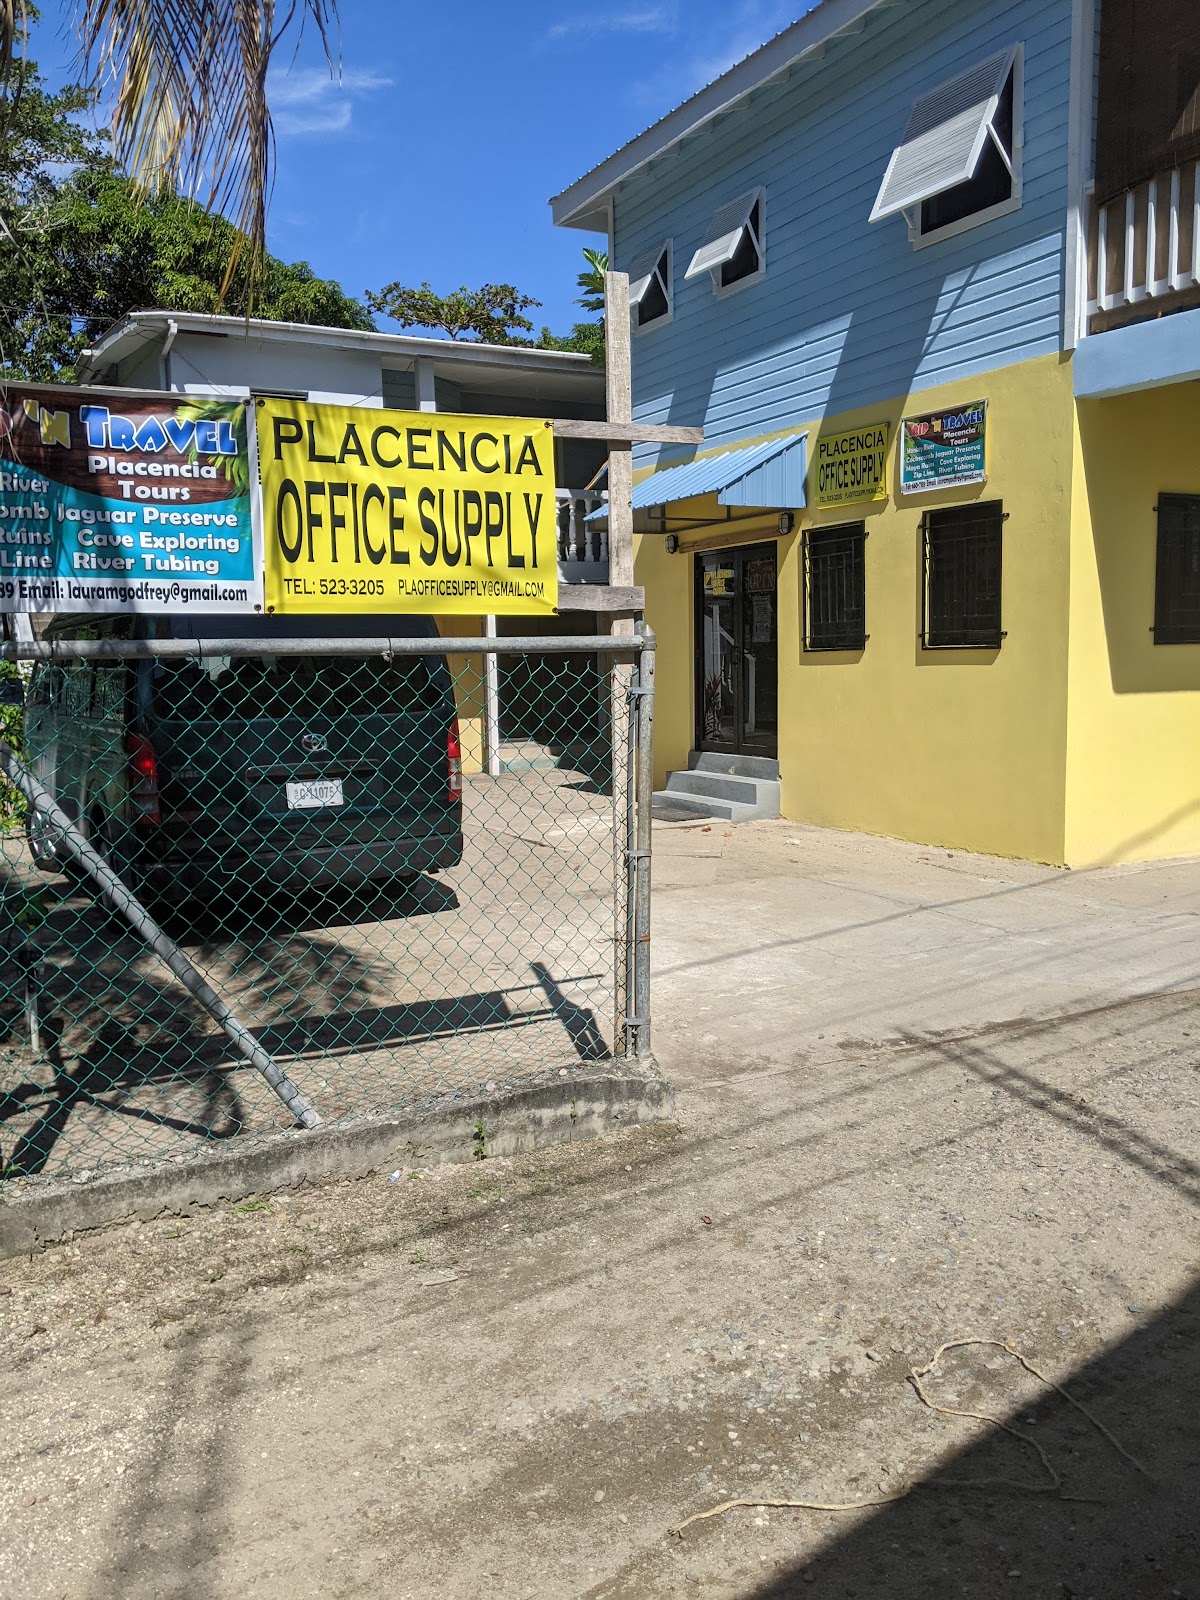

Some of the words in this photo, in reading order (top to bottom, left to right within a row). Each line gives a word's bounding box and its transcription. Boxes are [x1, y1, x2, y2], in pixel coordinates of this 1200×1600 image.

[943, 427, 976, 439] Placencia
[950, 438, 968, 446] Tours
[273, 417, 543, 475] PLACENCIA
[820, 431, 884, 458] PLACENCIA
[924, 444, 935, 452] River
[935, 450, 954, 458] Jaguar
[956, 444, 980, 454] Preserve
[88, 456, 217, 478] Placencia
[819, 459, 848, 492] OFFICE
[851, 452, 884, 486] SUPPLY
[906, 464, 920, 472] Maya
[954, 454, 981, 463] Exploring
[954, 463, 974, 471] Tubing
[0, 472, 50, 493] River
[118, 480, 190, 500] Tours
[57, 503, 136, 524] Jaguar
[143, 507, 237, 526] Preserve
[277, 478, 410, 568] OFFICE
[418, 486, 543, 571] SUPPLY
[78, 529, 133, 548] Cave
[139, 532, 240, 552] Exploring
[2, 551, 52, 570] Line
[73, 552, 134, 570] River
[141, 554, 219, 575] Tubing
[19, 580, 64, 599] Email:
[68, 582, 247, 603] lauramgodfrey@gmail.com
[284, 578, 316, 595] TEL:
[319, 579, 384, 595] 523-3205
[398, 580, 544, 597] PLAOFFICESUPPLY@GMAIL.COM
